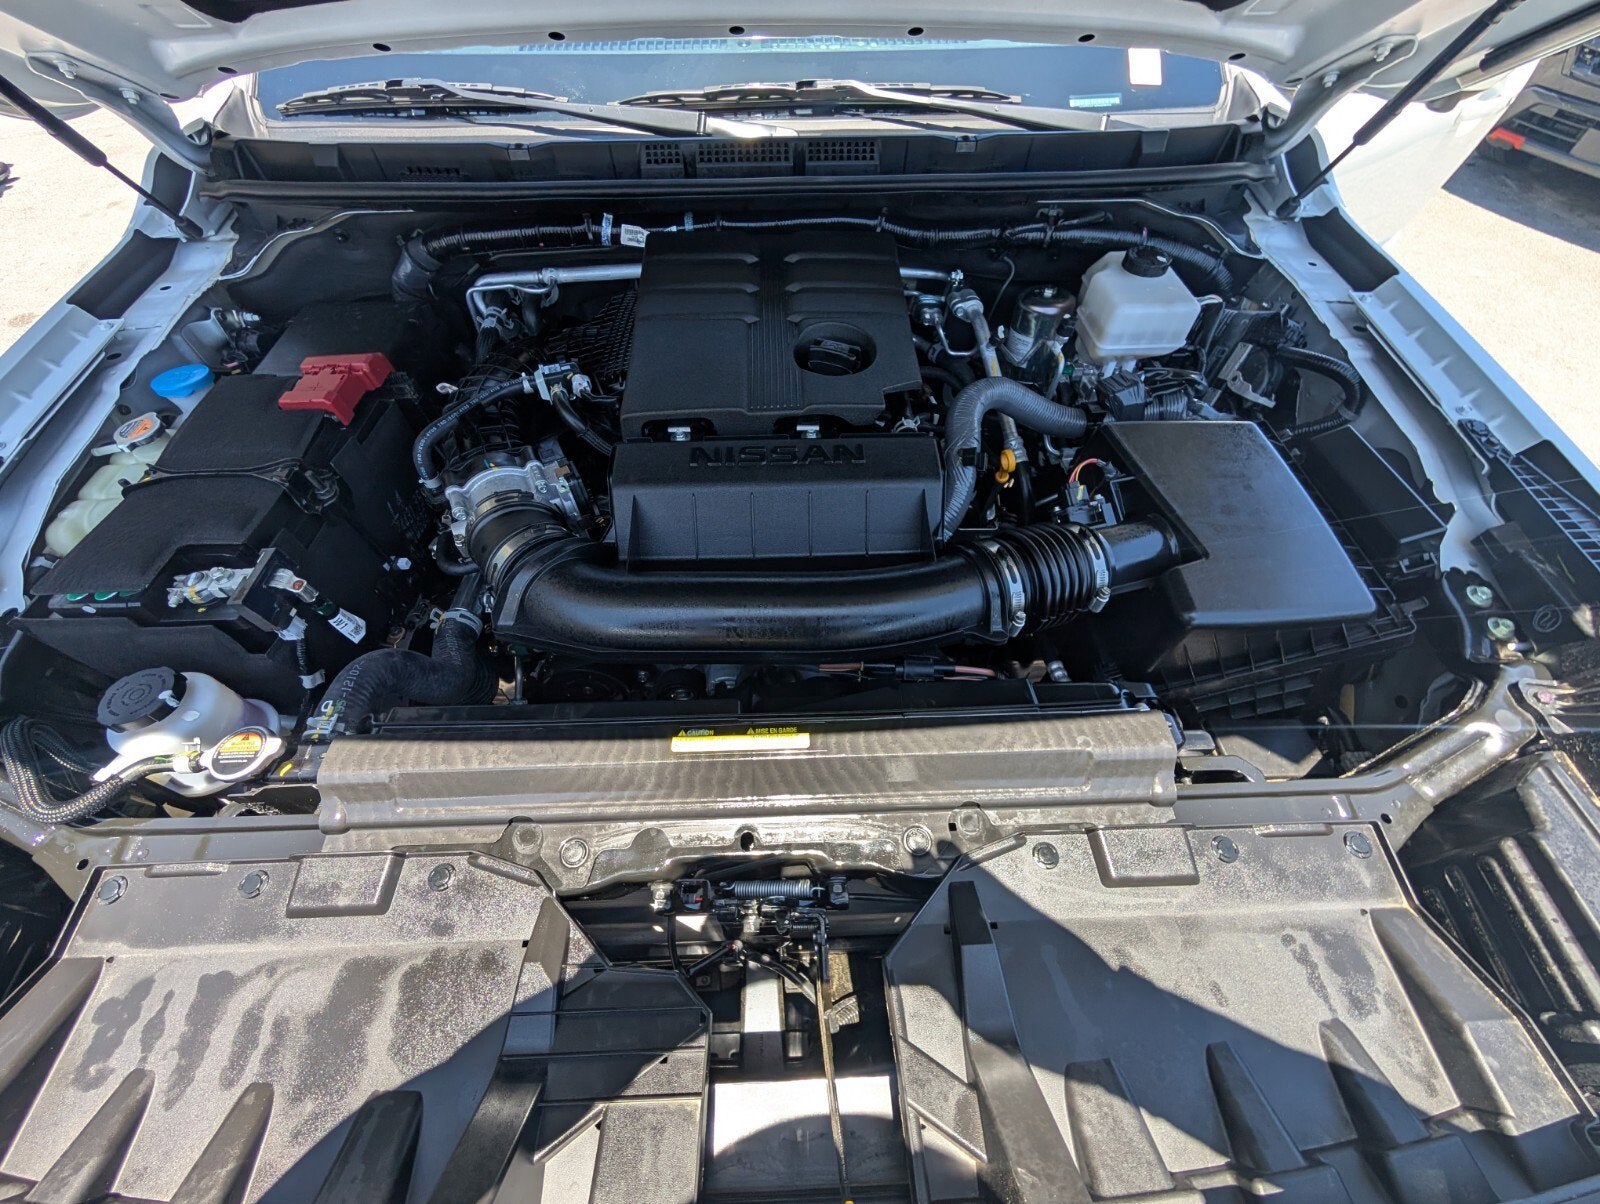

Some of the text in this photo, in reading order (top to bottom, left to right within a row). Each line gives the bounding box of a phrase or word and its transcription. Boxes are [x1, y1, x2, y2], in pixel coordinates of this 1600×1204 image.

[689, 444, 867, 467] NISSAN
[686, 729, 715, 737] CAUTION
[778, 726, 798, 734] GARDE
